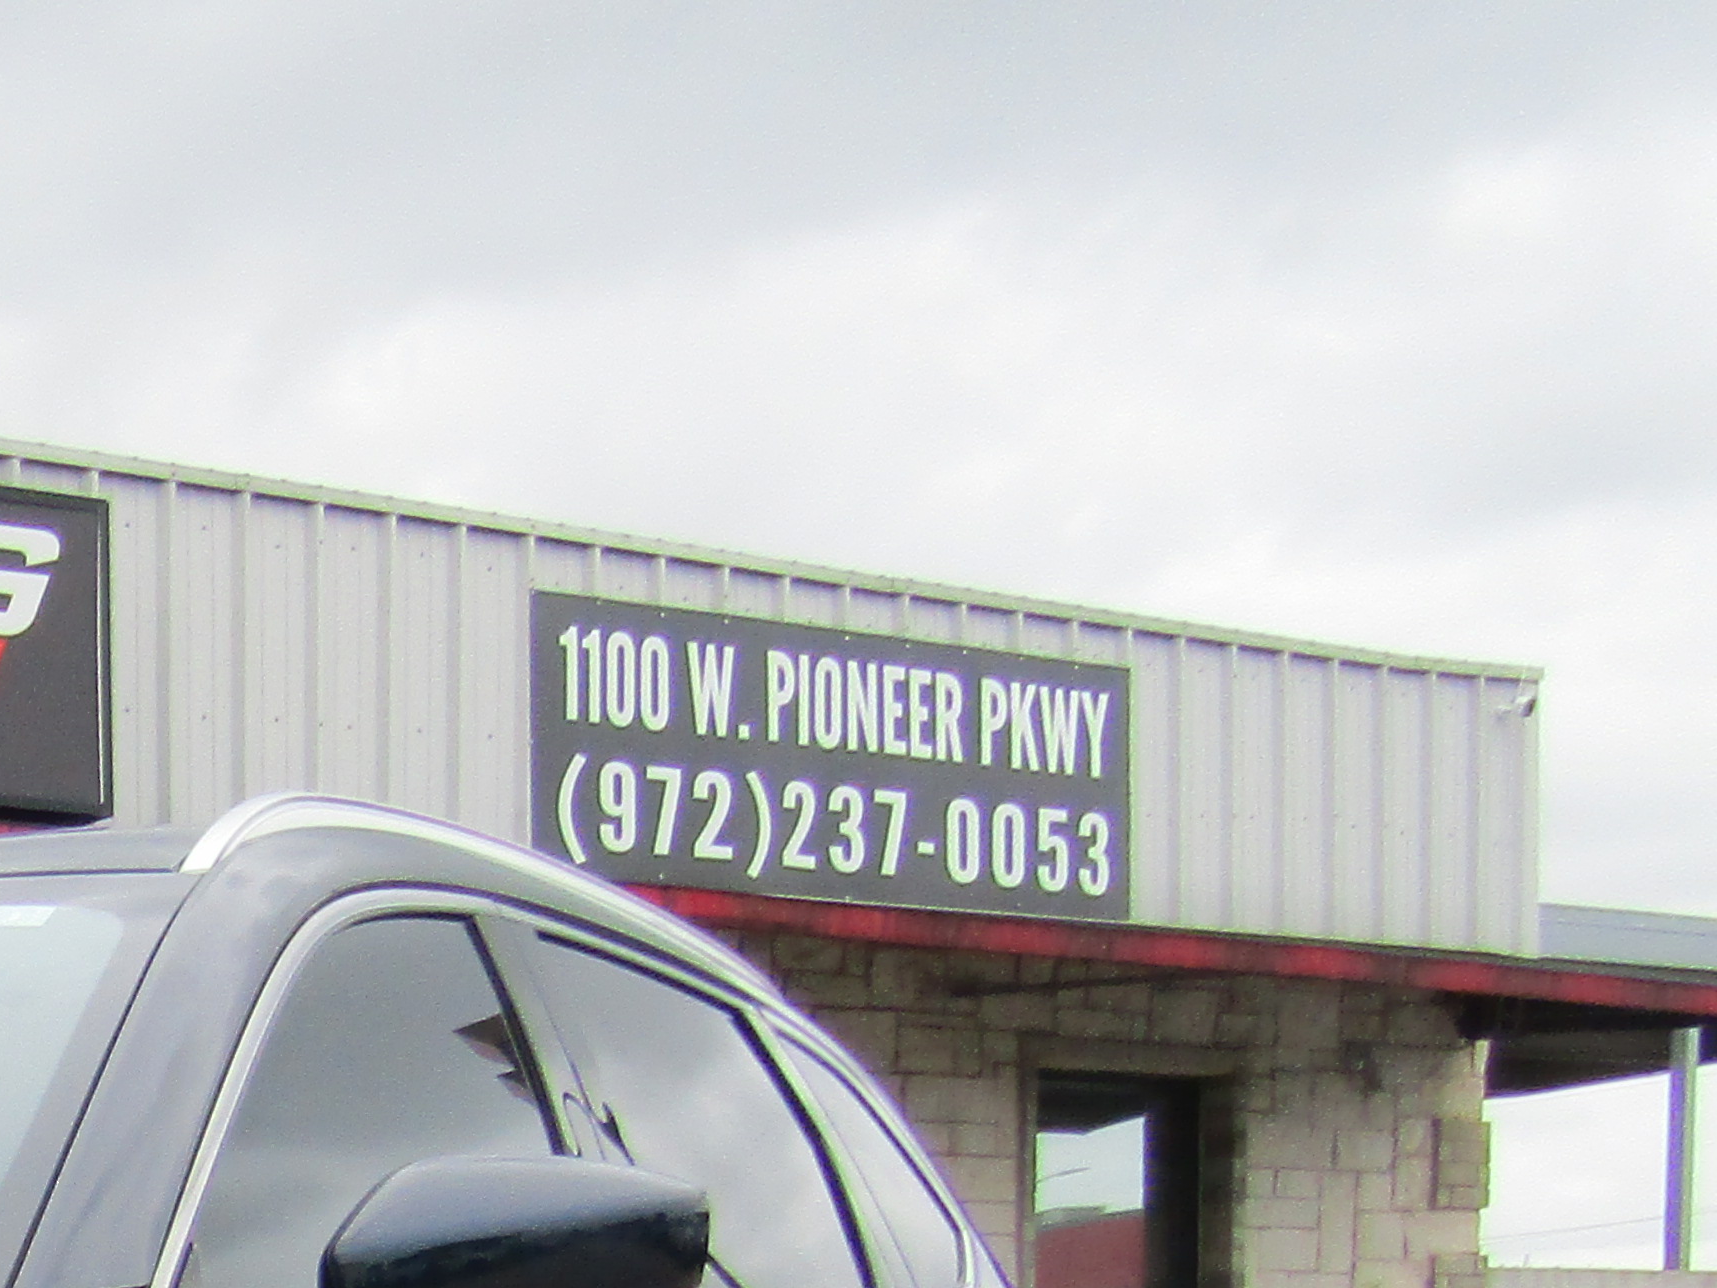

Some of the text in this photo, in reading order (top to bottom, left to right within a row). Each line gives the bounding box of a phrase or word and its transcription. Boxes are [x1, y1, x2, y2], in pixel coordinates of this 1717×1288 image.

[559, 625, 1112, 780] 1100 W. PIONEER PKWY
[558, 754, 1111, 898] (972)237-0053
